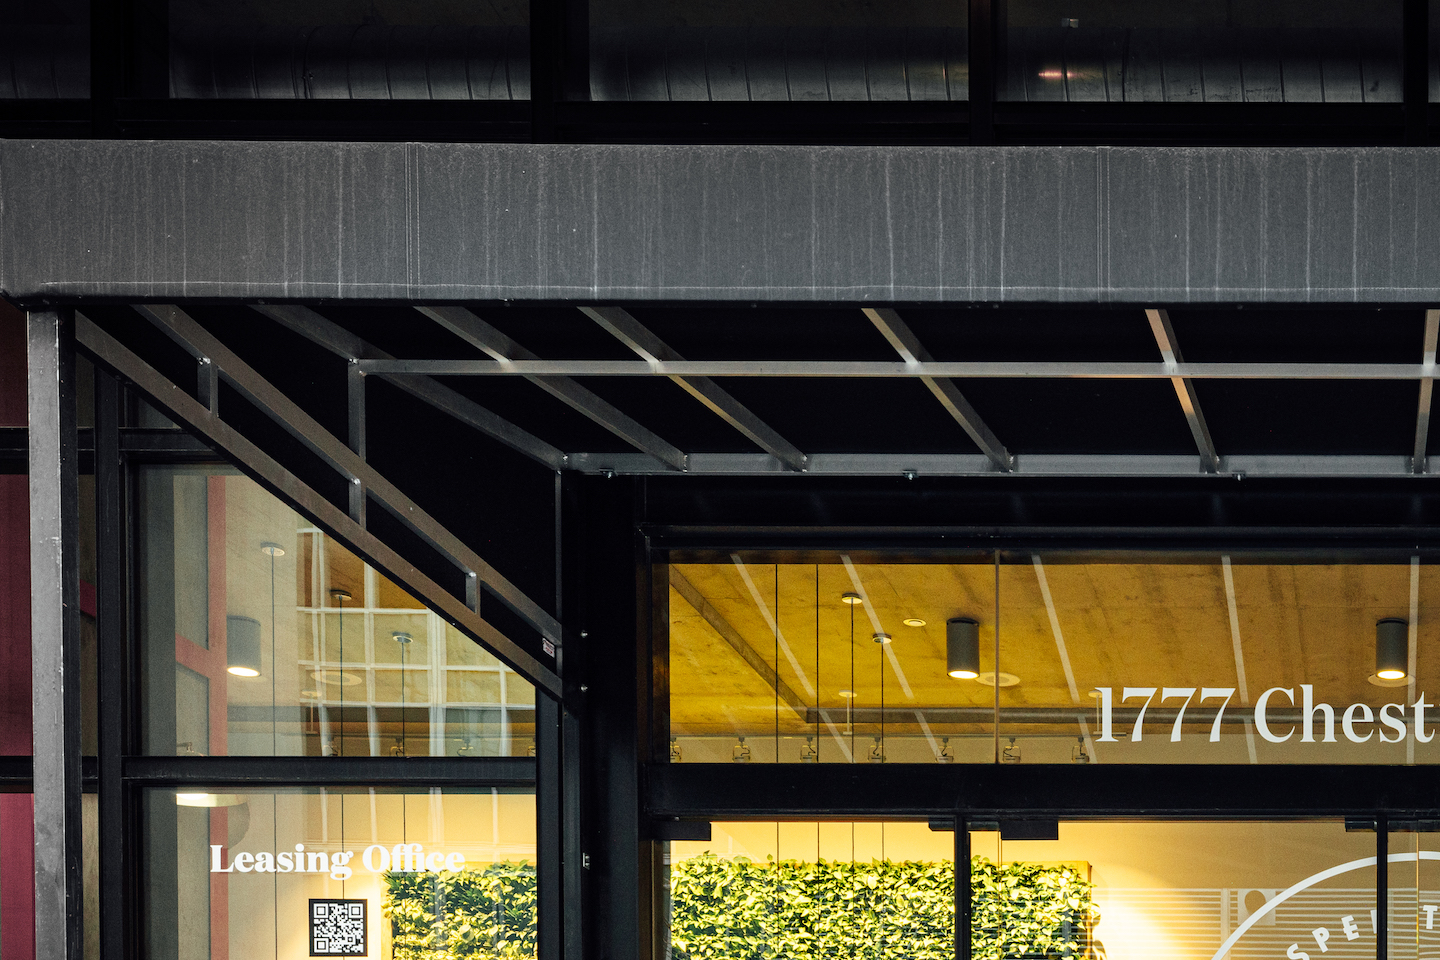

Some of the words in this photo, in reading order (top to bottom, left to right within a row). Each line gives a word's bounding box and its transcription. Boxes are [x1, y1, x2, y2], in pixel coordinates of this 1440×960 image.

[1094, 686, 1231, 744] 1777
[210, 844, 353, 880] Leasing
[362, 843, 466, 873] Office
